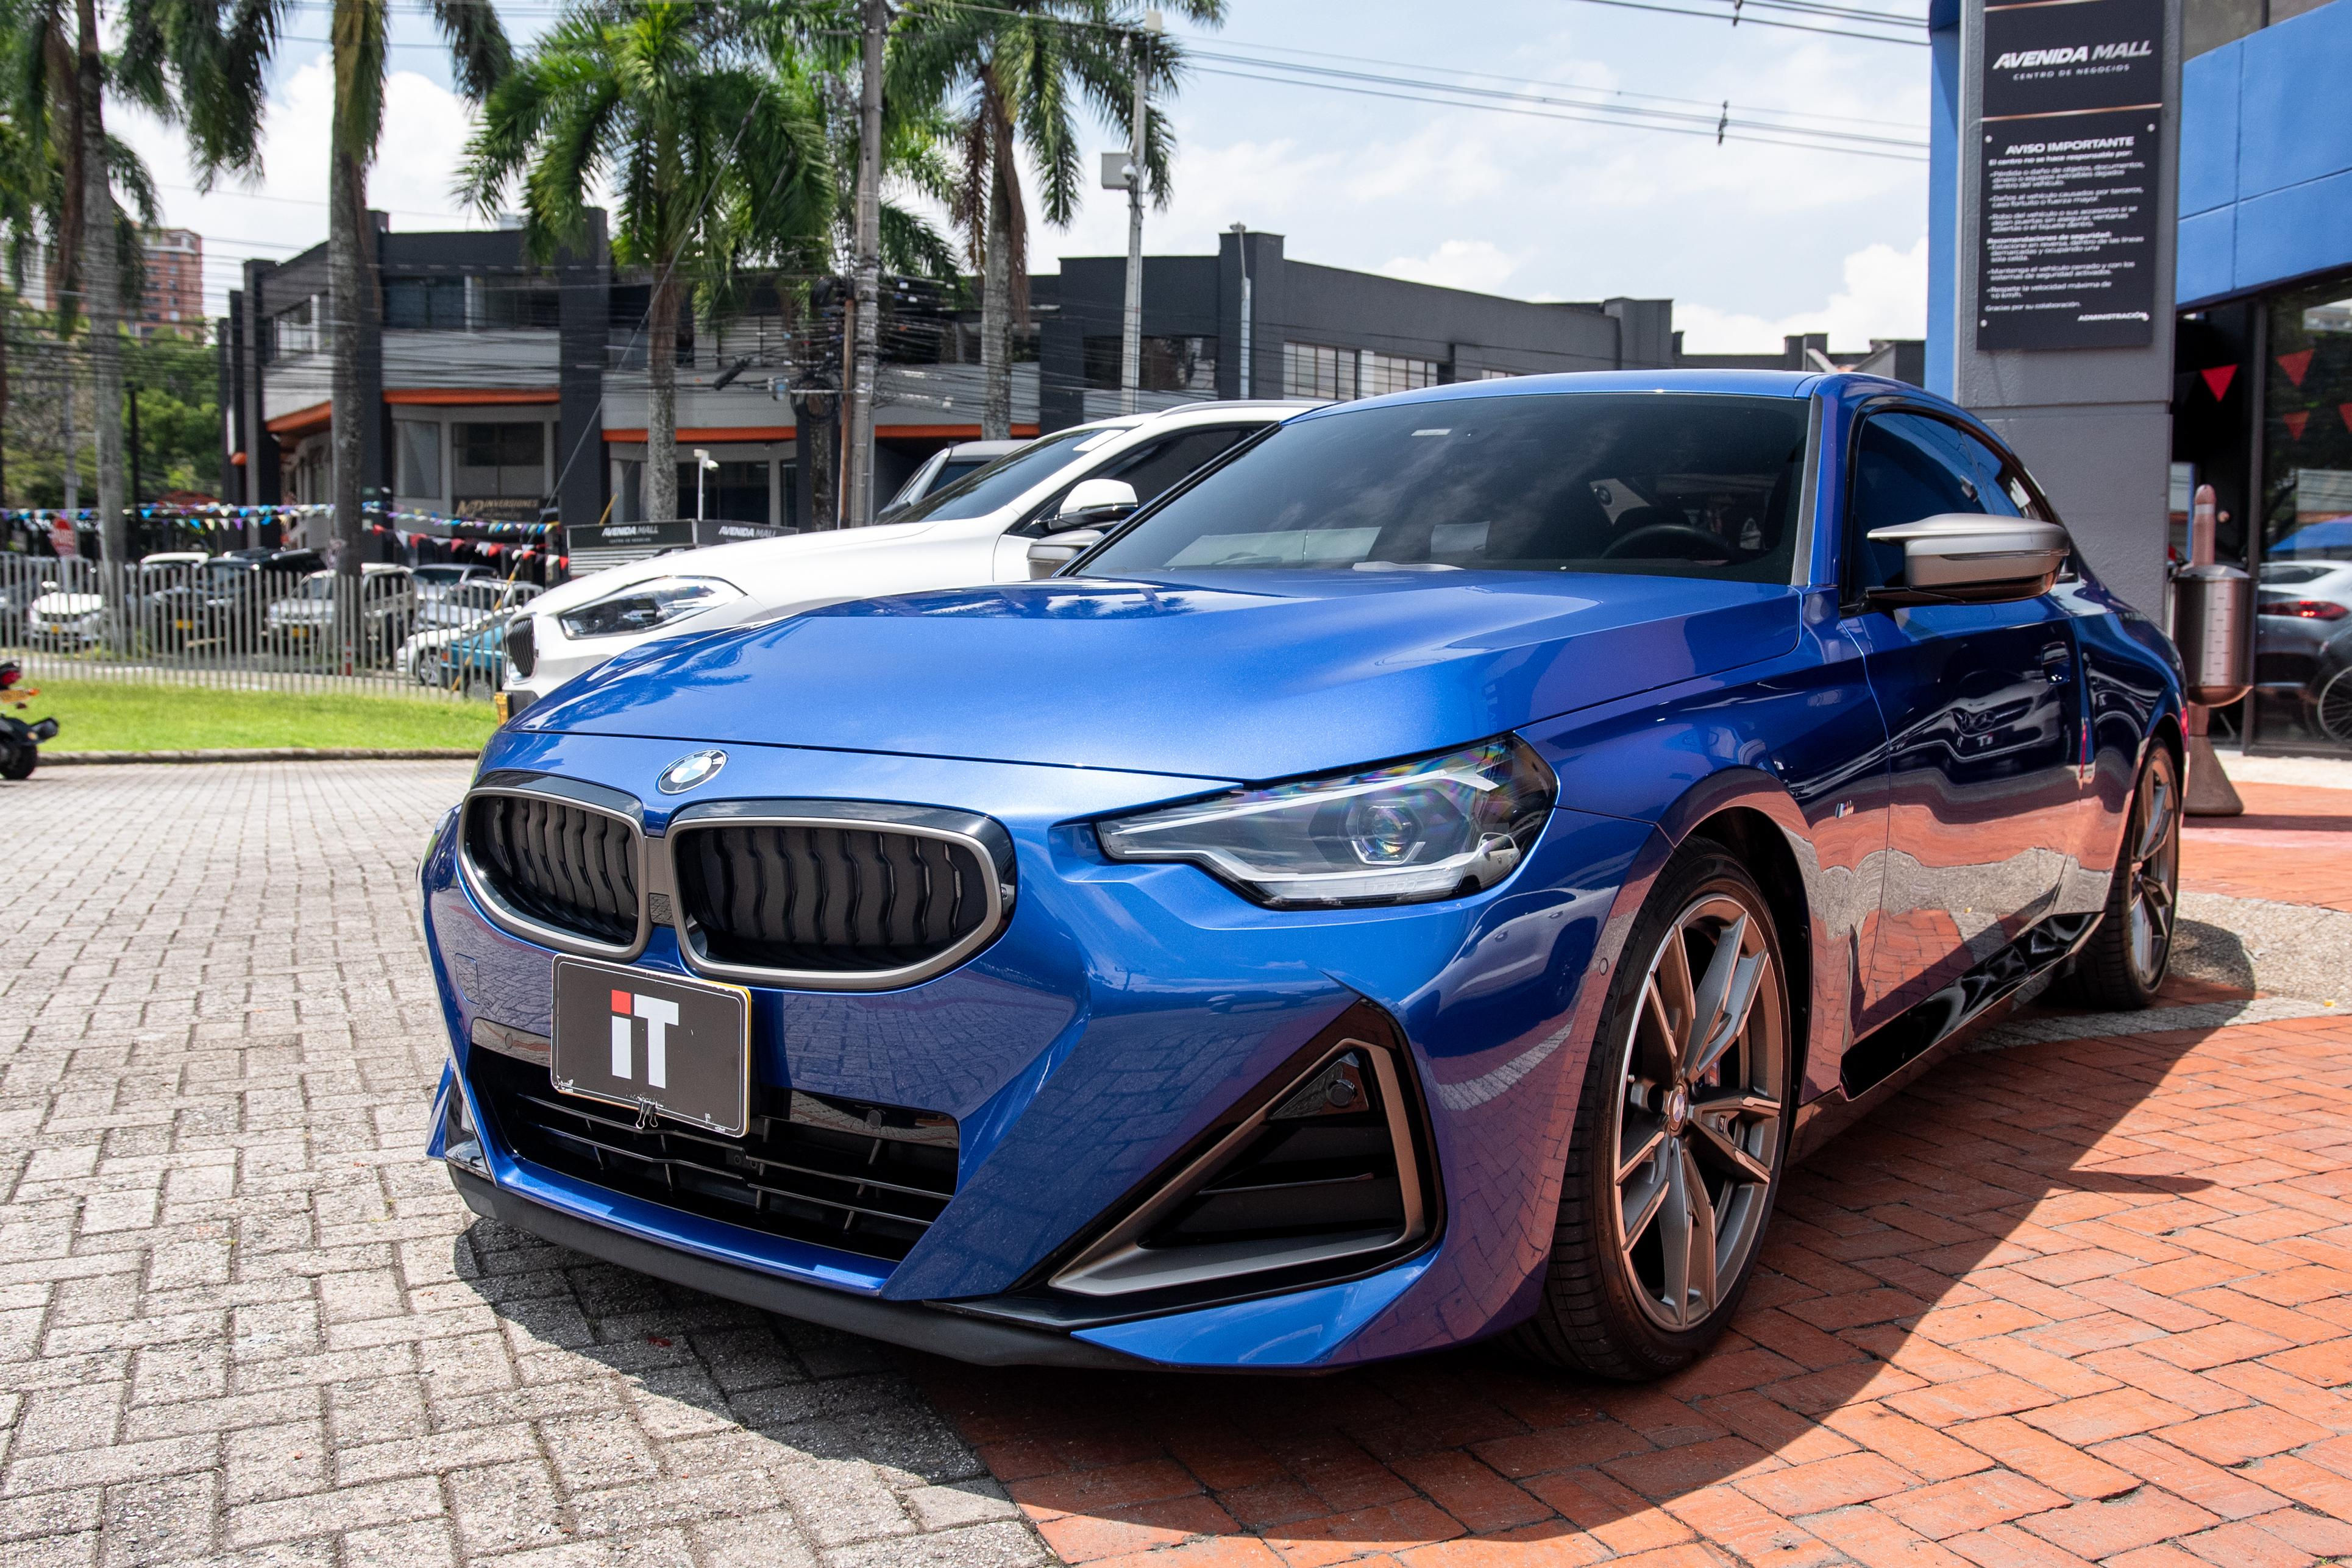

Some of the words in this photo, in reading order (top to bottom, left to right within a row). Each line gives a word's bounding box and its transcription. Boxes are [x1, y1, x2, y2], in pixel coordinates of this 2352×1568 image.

[1992, 46, 2088, 69] AVENIDA
[2091, 40, 2153, 60] MALL
[2013, 69, 2055, 80] CENTRO
[2058, 68, 2072, 77] DE
[2076, 63, 2130, 75] NEGOCIOS
[2005, 143, 2045, 154] AVISO
[2047, 137, 2133, 151] IMPORTANTE
[602, 526, 636, 536] AVENIDA
[637, 525, 659, 534] MALL
[719, 525, 755, 537] AVENIDA
